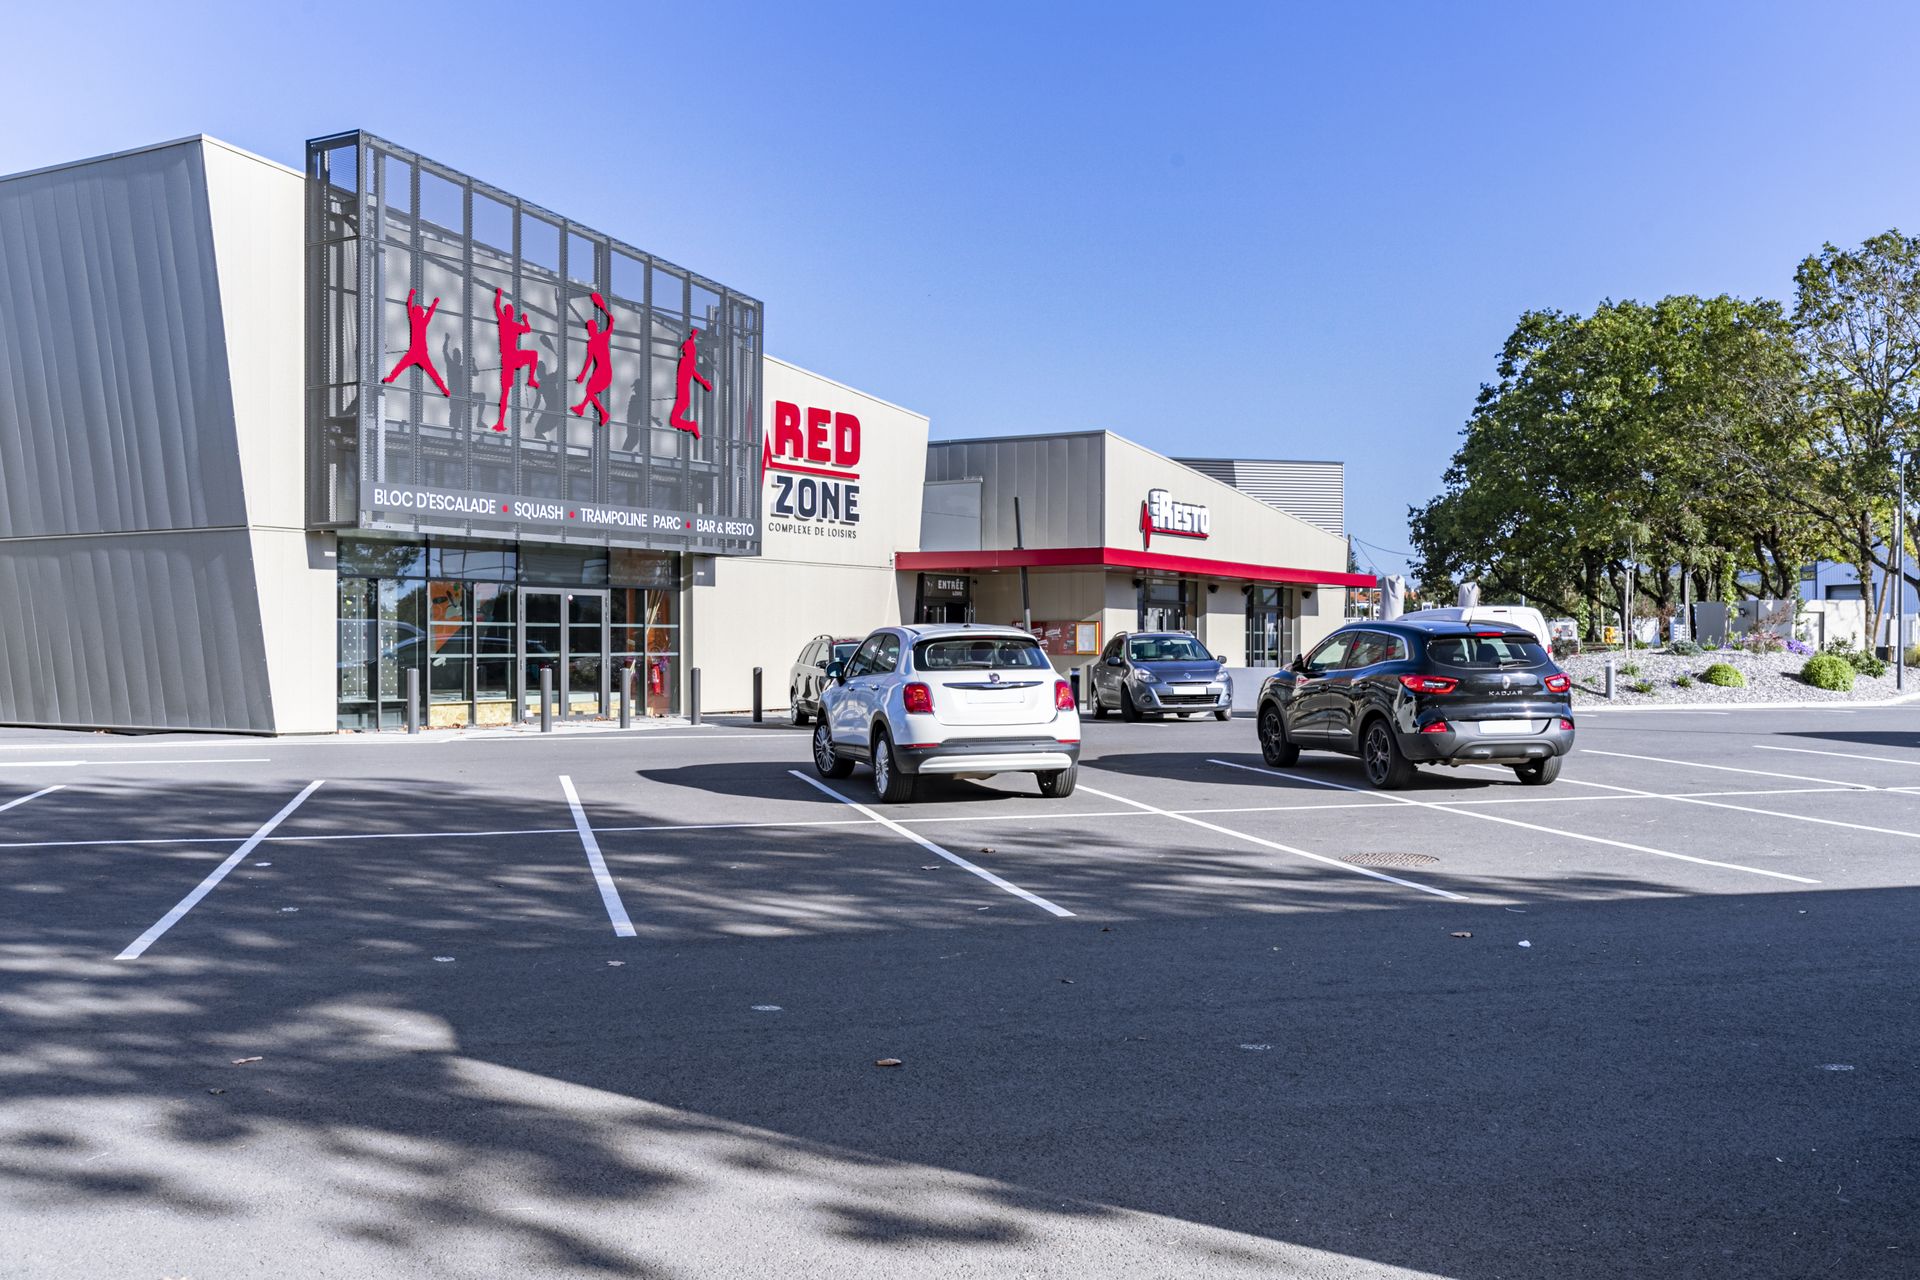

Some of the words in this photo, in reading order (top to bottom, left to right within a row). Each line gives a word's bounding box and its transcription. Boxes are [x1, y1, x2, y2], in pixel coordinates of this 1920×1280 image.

[775, 400, 861, 466] RED
[374, 488, 413, 508] BLOC
[416, 491, 497, 515] D'ESCALADE
[514, 501, 564, 521] SQUASH
[580, 507, 648, 528] TRAMPOLINE
[653, 514, 682, 530] PARC
[696, 519, 716, 534] BAR
[716, 522, 724, 534] &
[725, 521, 755, 537] RESTO
[775, 474, 861, 523] ZONE
[1159, 491, 1210, 534] RESTO
[768, 522, 811, 535] COMPLEXE
[814, 526, 825, 536] DE
[827, 528, 857, 539] LOISIRS
[937, 578, 964, 590] ENTRÉE
